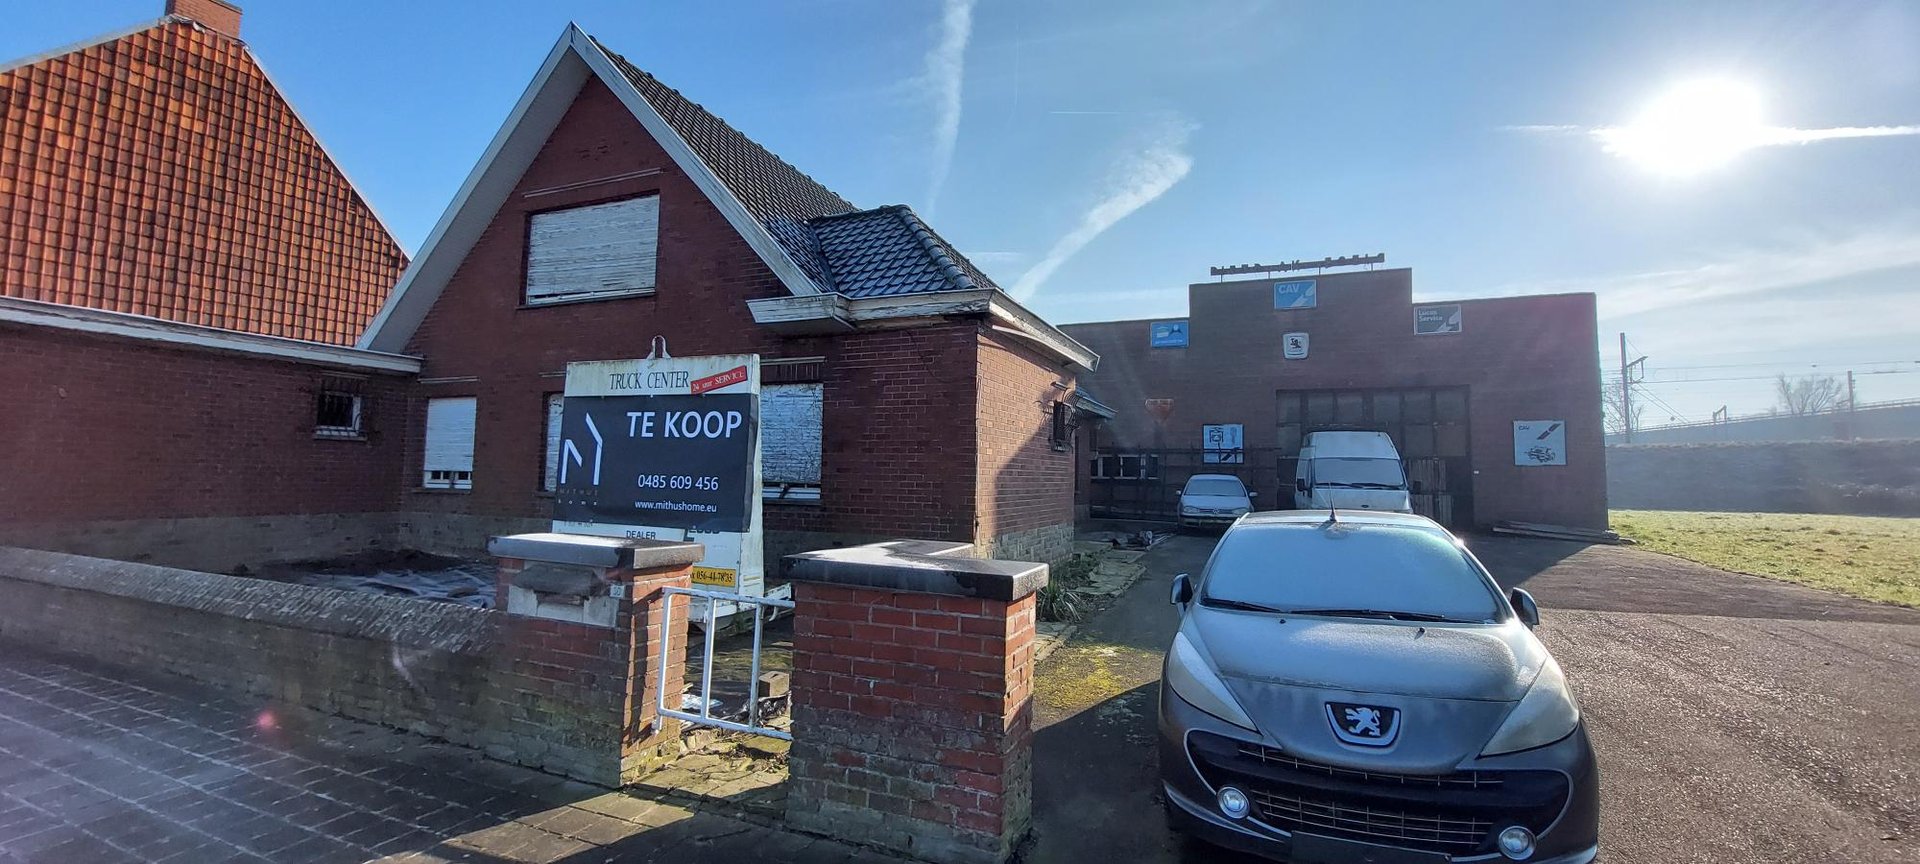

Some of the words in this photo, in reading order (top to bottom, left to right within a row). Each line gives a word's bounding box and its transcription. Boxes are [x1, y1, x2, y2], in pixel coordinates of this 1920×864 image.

[1279, 284, 1300, 294] CAV
[610, 372, 641, 390] TRUCK
[647, 370, 689, 389] CENTER
[626, 411, 656, 438] TE
[664, 410, 742, 439] KOOP
[637, 474, 666, 489] 0485
[669, 475, 692, 490] 609
[695, 476, 719, 491] 456
[634, 500, 717, 513] www.mithushome.eu
[626, 530, 656, 540] DEALER
